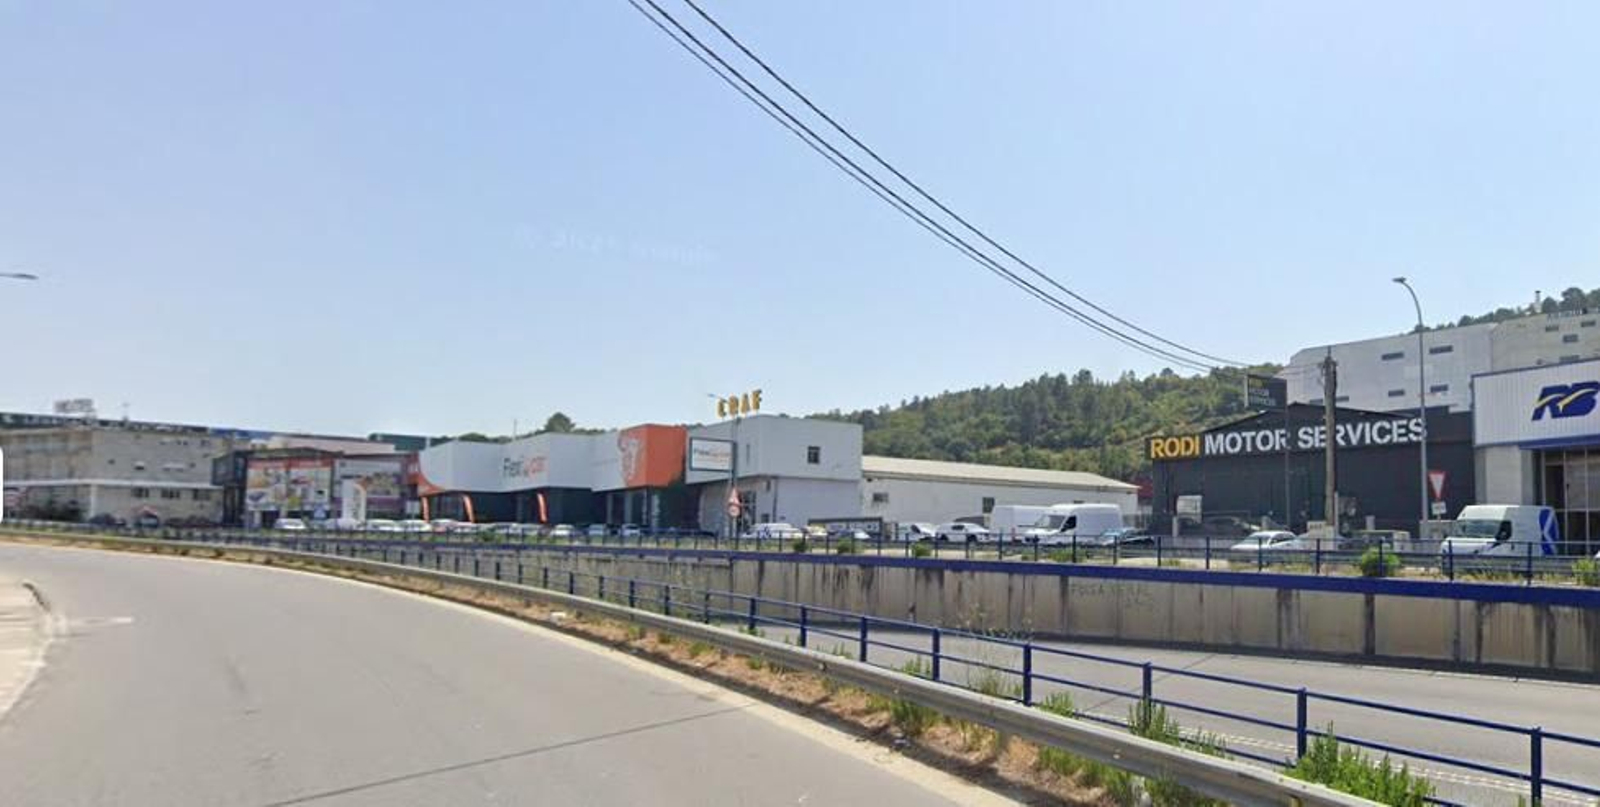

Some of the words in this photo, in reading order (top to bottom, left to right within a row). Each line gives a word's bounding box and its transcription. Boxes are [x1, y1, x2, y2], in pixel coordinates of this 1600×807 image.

[1150, 436, 1200, 459] RODI
[1204, 429, 1291, 455] MOTOR
[1297, 418, 1427, 449] SERVICES
